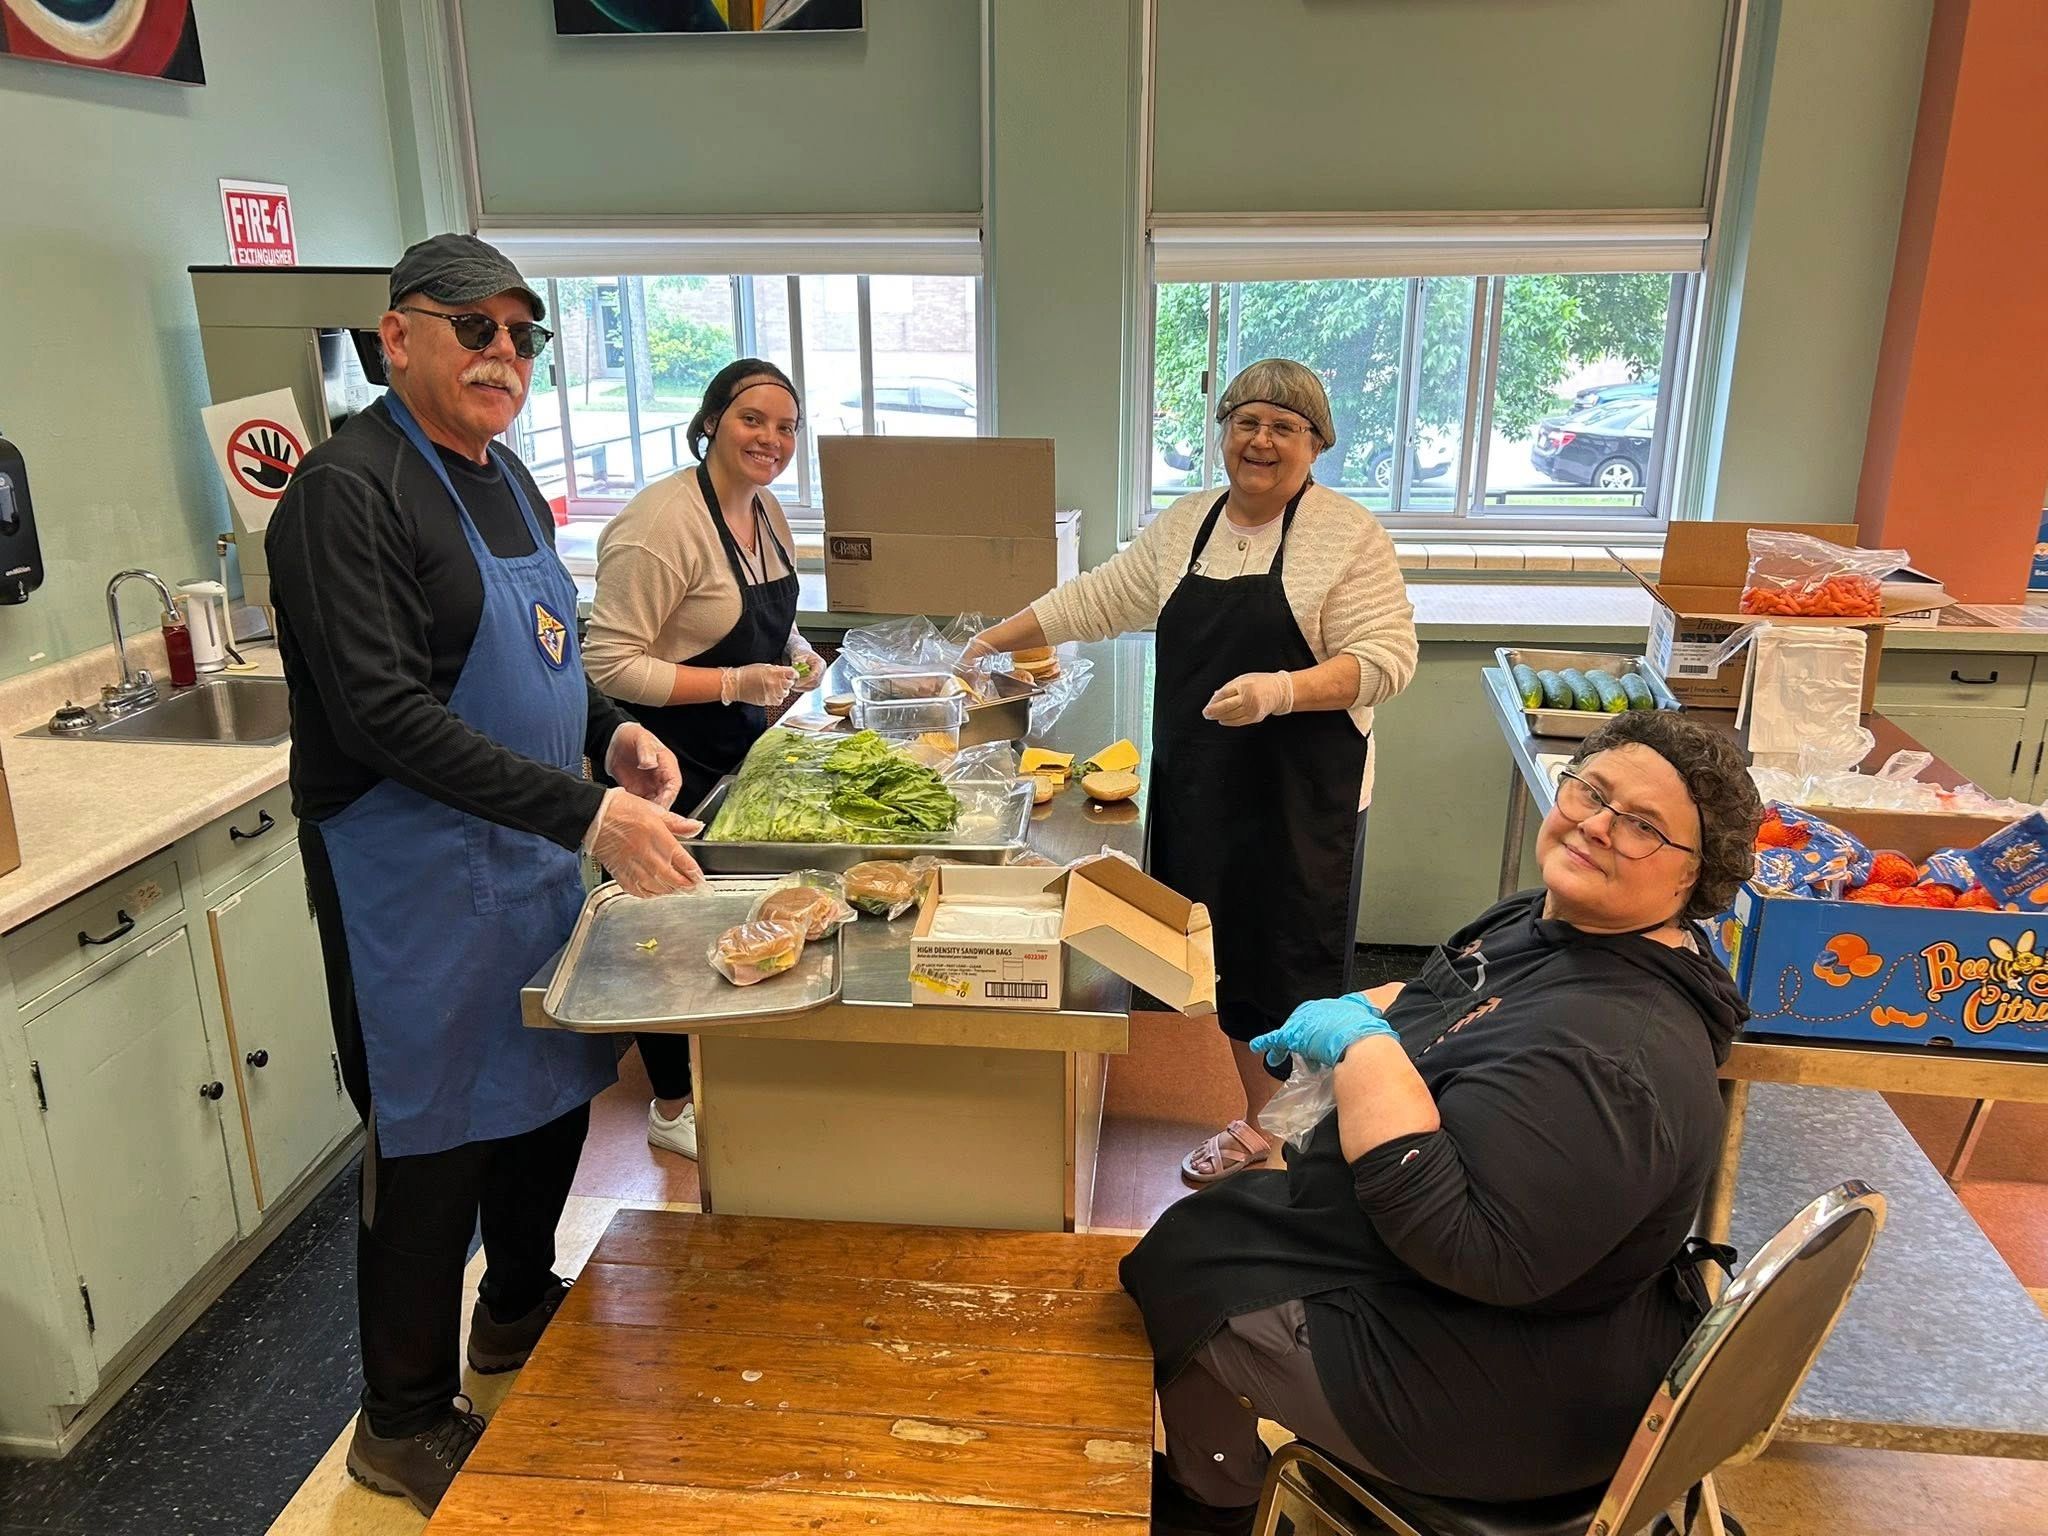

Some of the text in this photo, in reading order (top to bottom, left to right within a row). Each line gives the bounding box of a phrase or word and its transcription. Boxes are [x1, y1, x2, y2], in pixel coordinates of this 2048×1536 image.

[229, 197, 275, 244] FIRE
[237, 248, 294, 265] EXTINGUISHER
[934, 946, 960, 954] DENSITY
[961, 947, 995, 955] SANDWICH
[996, 948, 1012, 956] BAGS
[1920, 940, 1990, 1002] Bee
